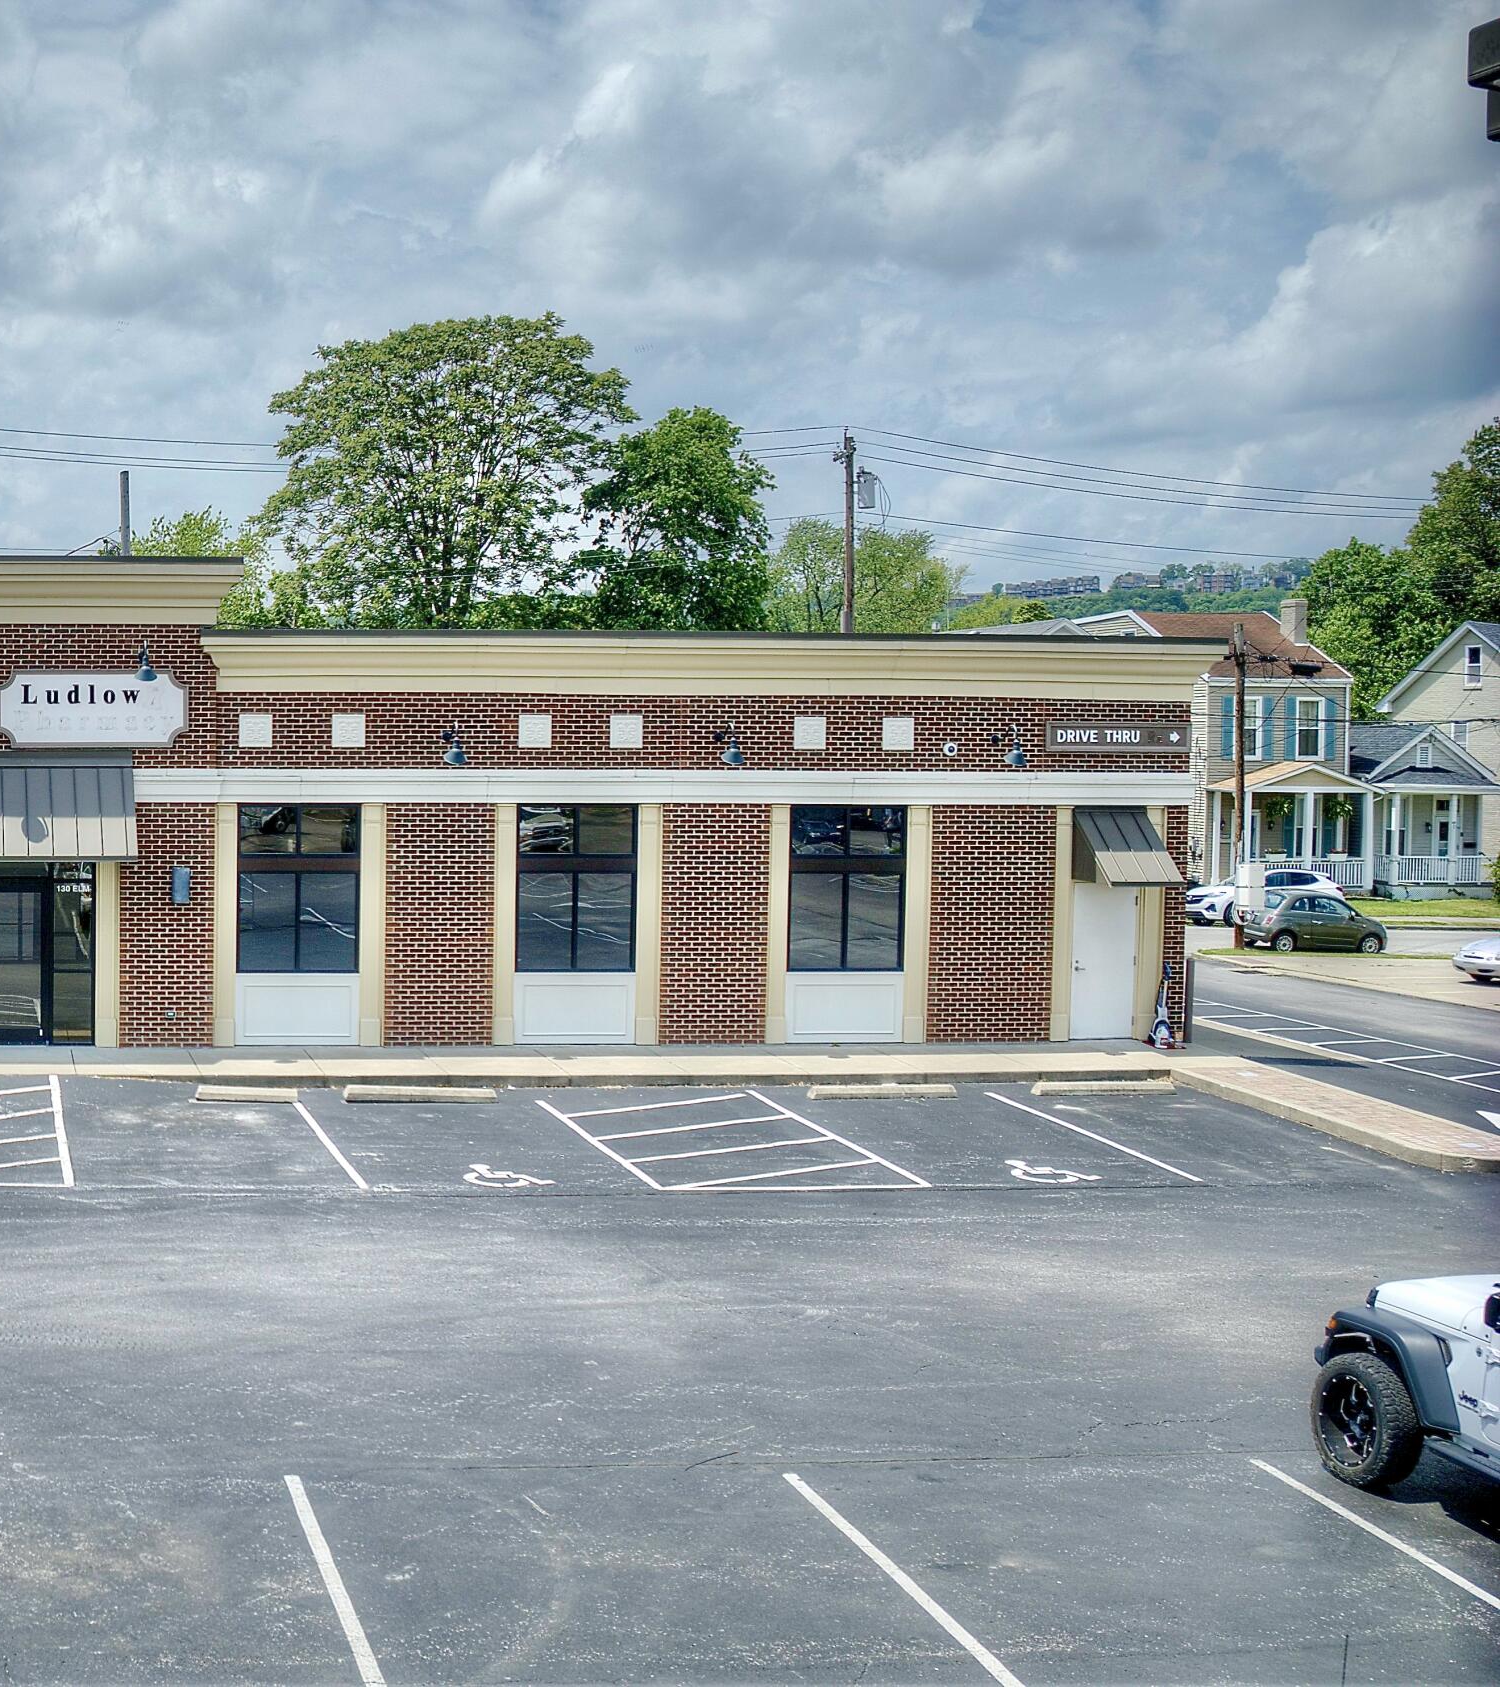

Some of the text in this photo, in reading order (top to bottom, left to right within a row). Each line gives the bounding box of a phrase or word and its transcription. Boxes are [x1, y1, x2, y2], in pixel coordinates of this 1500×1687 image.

[20, 684, 140, 704] Ludlow
[1056, 729, 1099, 743] DRIVE
[1104, 729, 1141, 743] THRU
